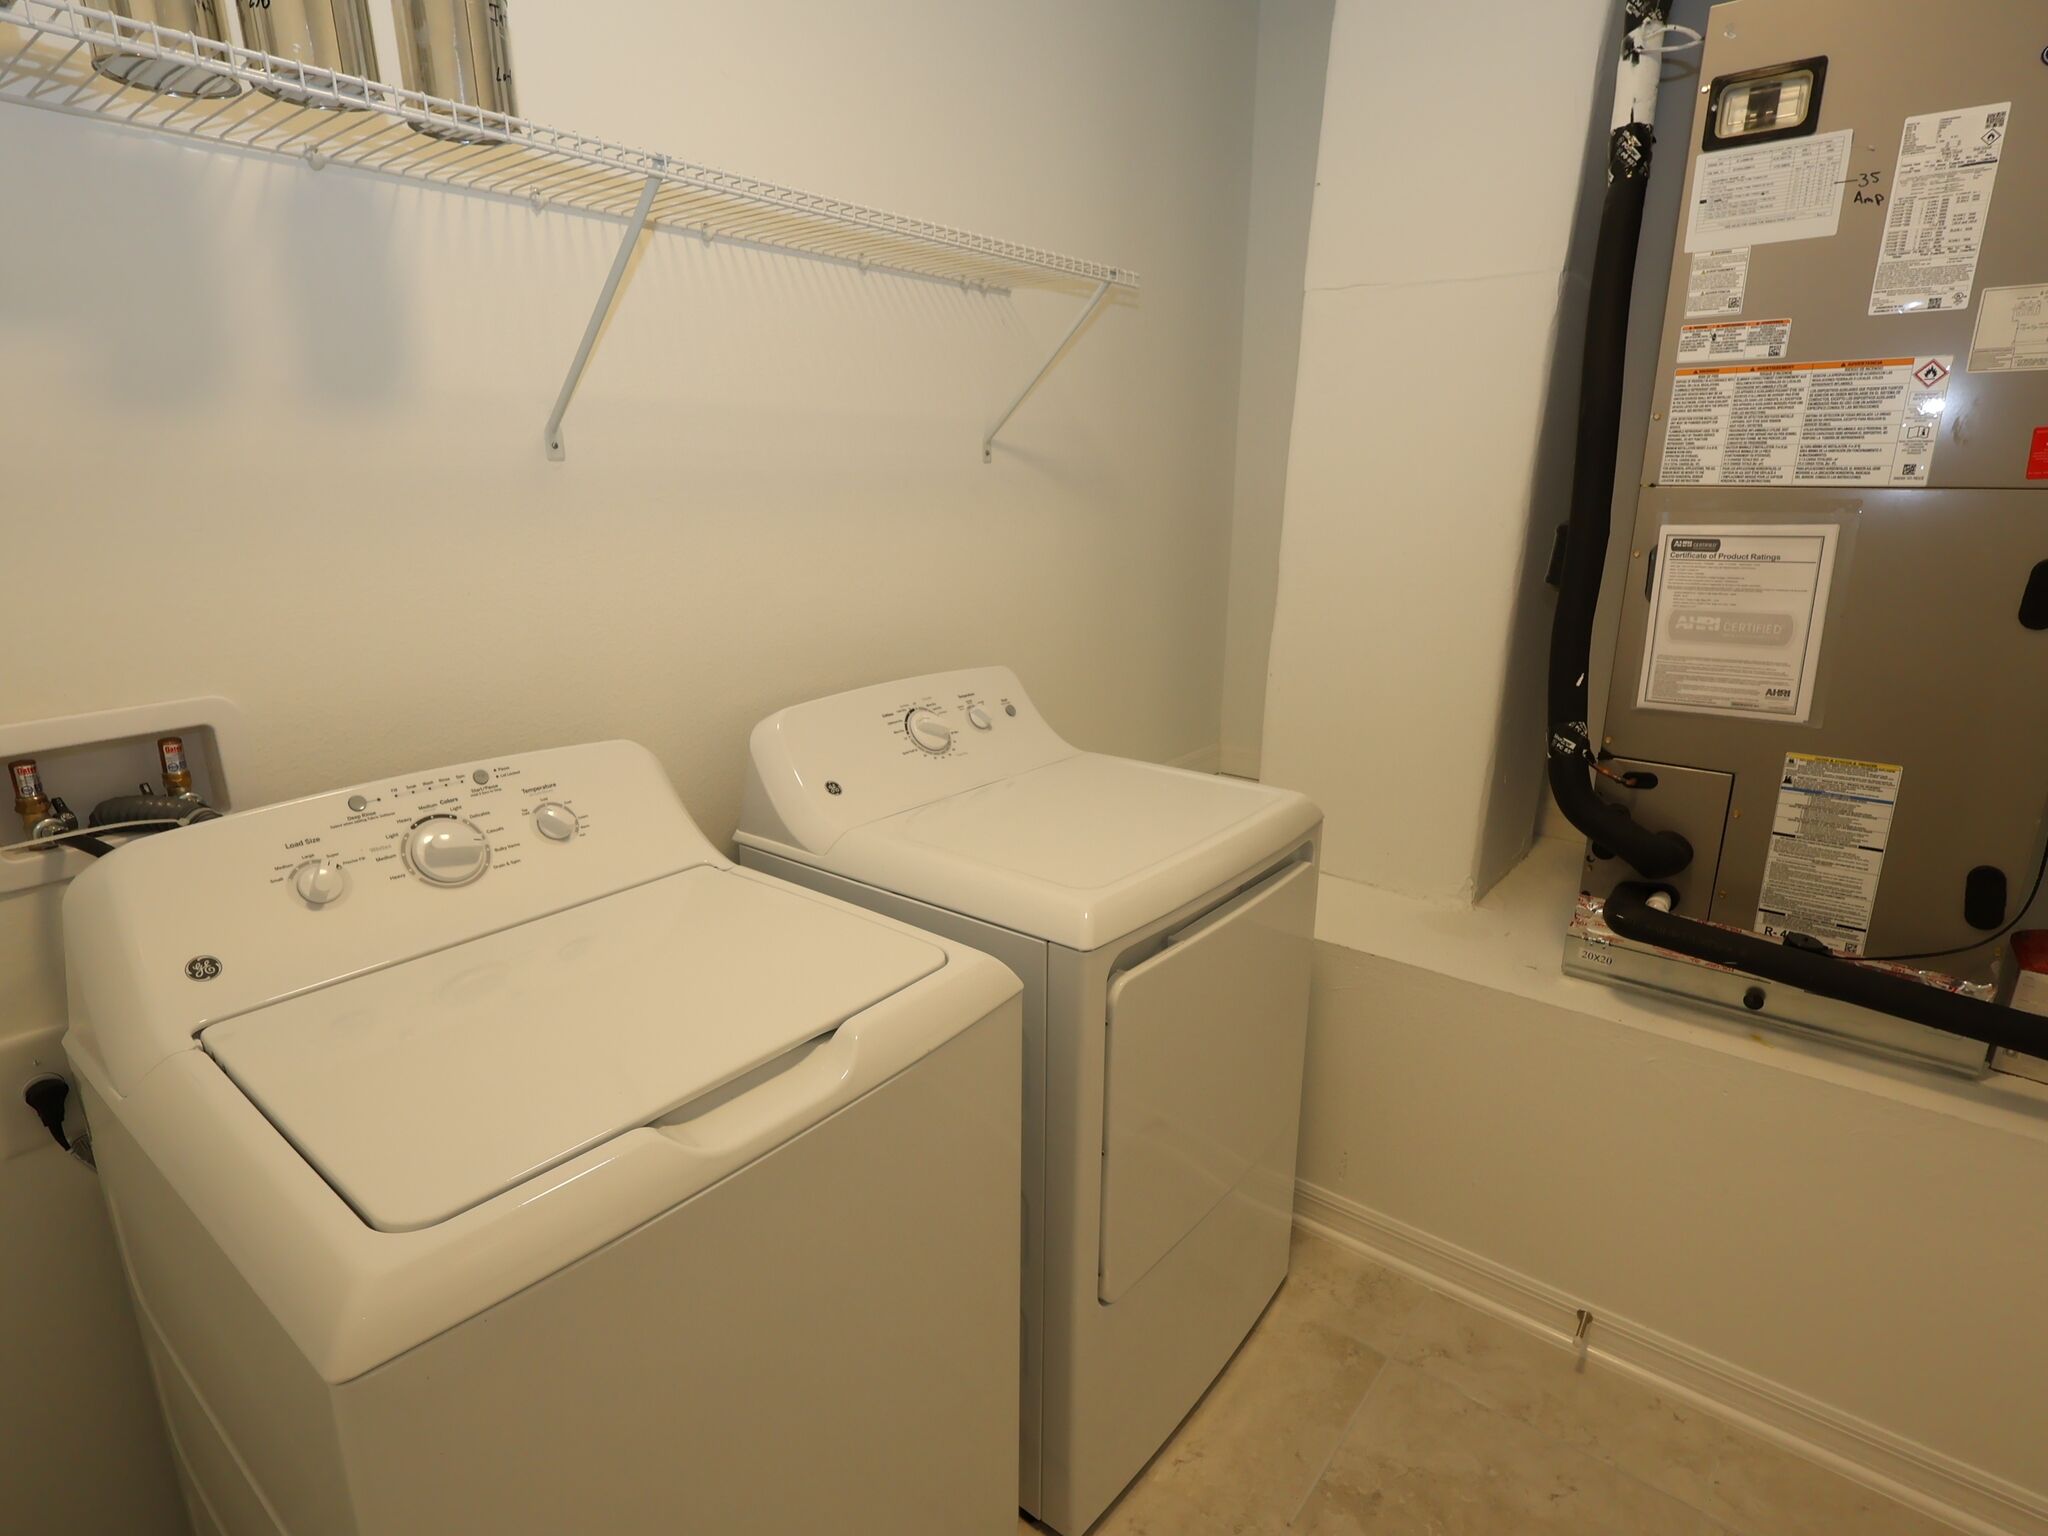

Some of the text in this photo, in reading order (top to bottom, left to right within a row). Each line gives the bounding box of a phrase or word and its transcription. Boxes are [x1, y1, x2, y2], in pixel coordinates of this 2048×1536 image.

[1858, 171, 1881, 188] 35
[1750, 554, 1781, 562] Ratings
[1723, 622, 1782, 634] CERTIFIED
[521, 782, 556, 794] Temperature
[440, 797, 459, 805] Colors
[285, 837, 321, 850] Load Size
[375, 853, 397, 862] Medium
[1582, 950, 1613, 965] 20X20
